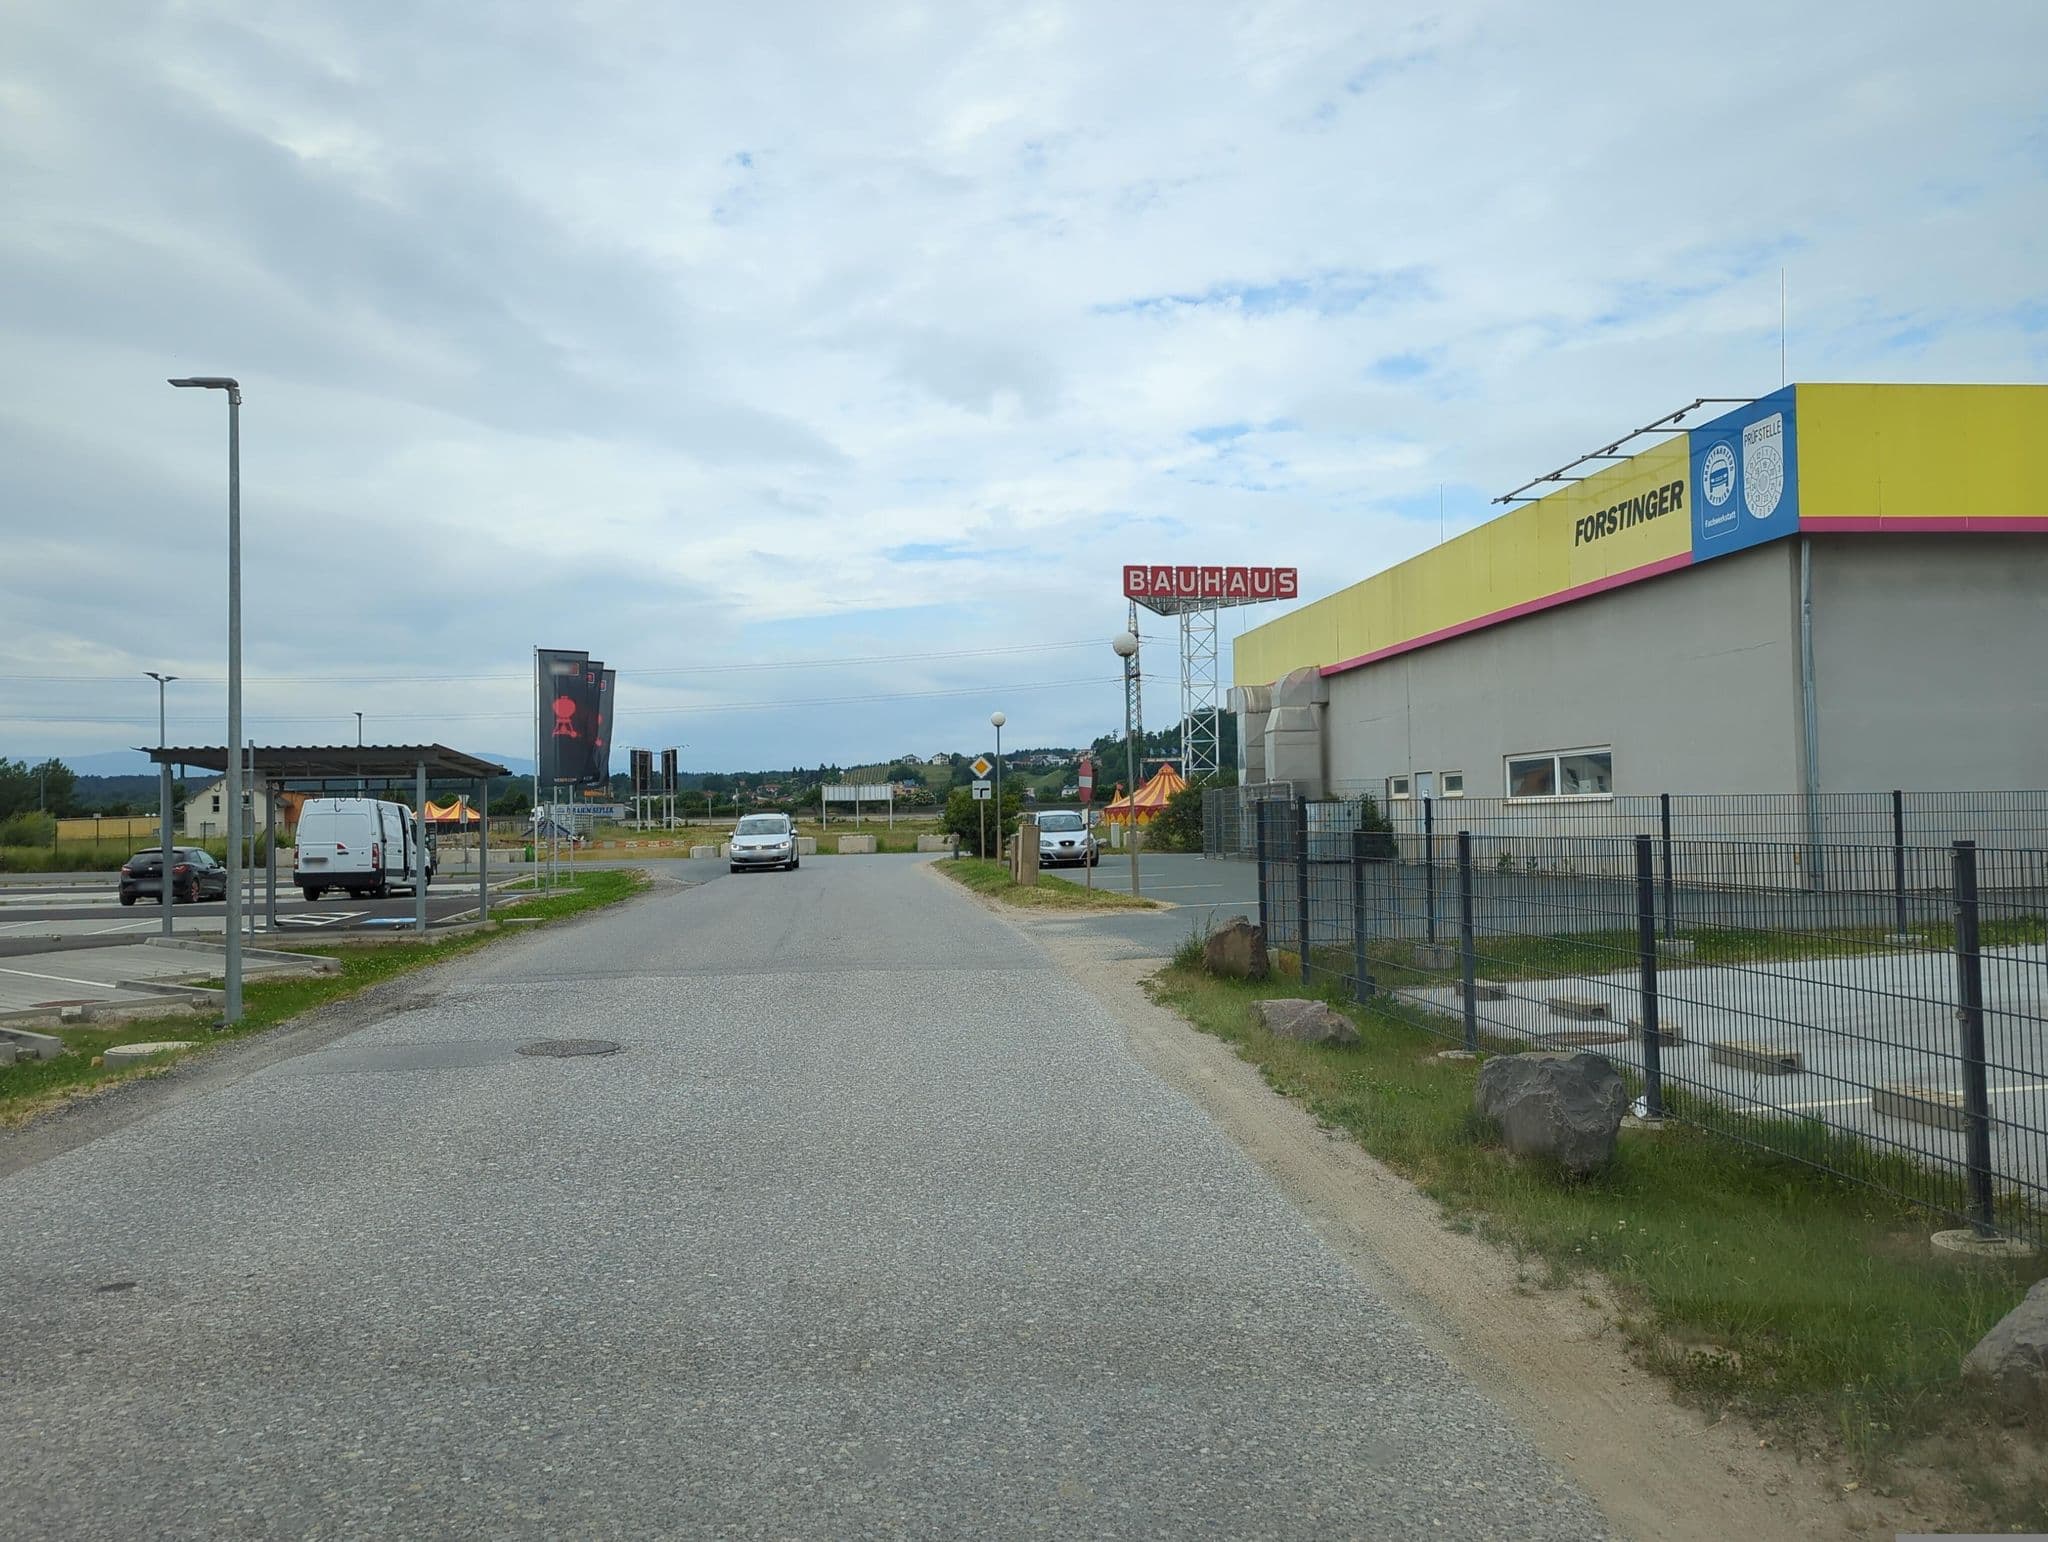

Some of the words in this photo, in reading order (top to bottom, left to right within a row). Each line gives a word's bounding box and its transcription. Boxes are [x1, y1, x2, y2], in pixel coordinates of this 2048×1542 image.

[1744, 420, 1782, 446] PRÜFSTELLE
[1575, 480, 1684, 547] FORSTINGER
[1129, 570, 1295, 593] BAUHAUS
